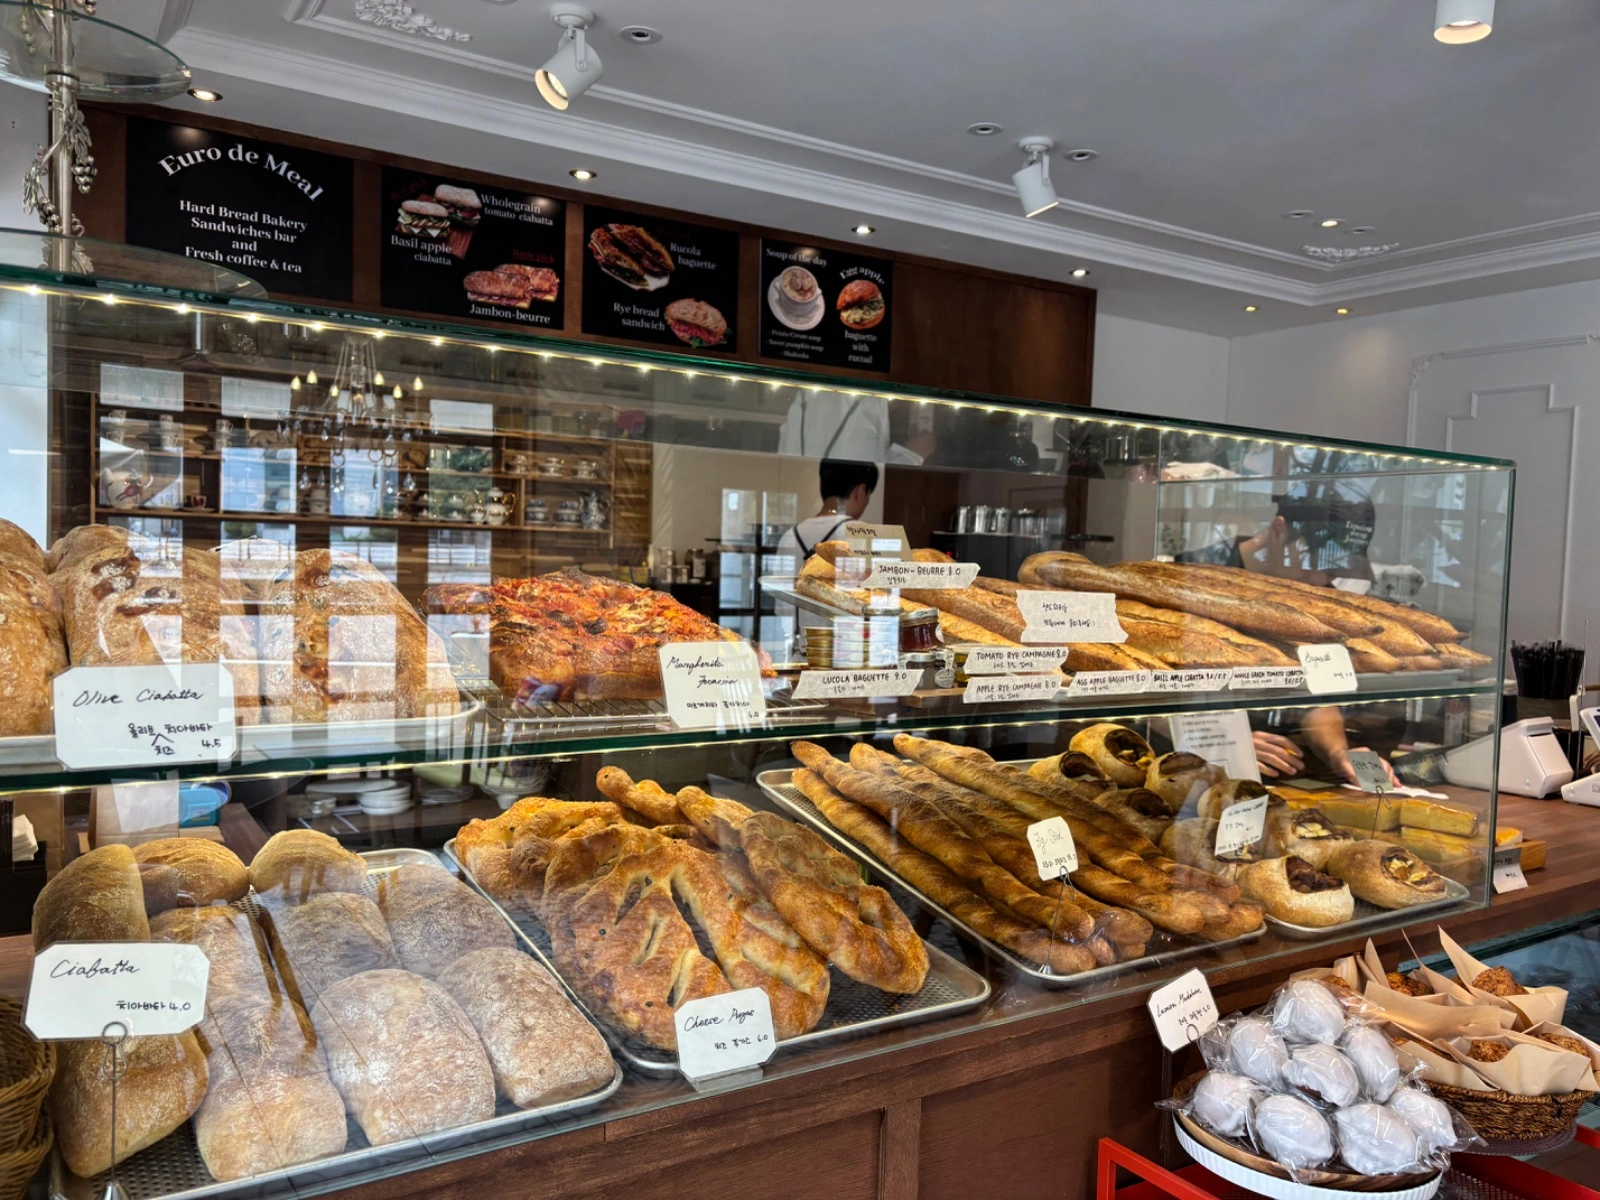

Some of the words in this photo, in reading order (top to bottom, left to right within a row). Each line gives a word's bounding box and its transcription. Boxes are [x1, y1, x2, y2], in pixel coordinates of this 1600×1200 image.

[158, 146, 222, 176] Euro
[227, 143, 260, 164] de
[263, 153, 325, 201] Meal
[480, 193, 541, 214] Wholegrain
[179, 200, 215, 216] Hard
[218, 206, 259, 223] Bread
[262, 213, 308, 233] Bakery
[484, 207, 516, 219] tomato
[518, 212, 553, 226] ciabatta
[191, 217, 272, 240] Sandwiches
[274, 231, 297, 244] bar
[231, 240, 258, 252] and
[391, 234, 418, 249] Basil
[420, 239, 452, 255] apple
[670, 242, 702, 256] Rucola
[185, 246, 223, 262] Fresh
[226, 254, 268, 269] coffee
[270, 260, 280, 270] &
[282, 261, 303, 273] tea
[414, 252, 452, 266] ciabatta
[677, 255, 717, 270] baguette
[766, 248, 789, 261] Soup
[812, 255, 828, 268] day
[469, 303, 551, 324] Jambon-beurre
[613, 302, 631, 314] Rye
[633, 305, 660, 318] bread
[621, 316, 666, 331] sandwich
[844, 329, 877, 341] baguette
[852, 343, 870, 352] with
[976, 651, 1004, 661] TOMATO
[1006, 651, 1020, 660] RYE
[853, 673, 890, 683] BAGUETTE
[1089, 677, 1106, 685] APPLE
[976, 684, 995, 693] APPLE
[998, 684, 1010, 693] RYE
[73, 690, 123, 707] Olive
[136, 688, 205, 702] Ciabatta
[128, 722, 156, 739] 올리브
[164, 723, 213, 733] 치아바타
[201, 738, 222, 749] 4.5
[50, 957, 141, 979] Ciabatta
[115, 1000, 166, 1011] 치아바타
[169, 1002, 191, 1012] 4.0
[1156, 1002, 1178, 1018] Lemon
